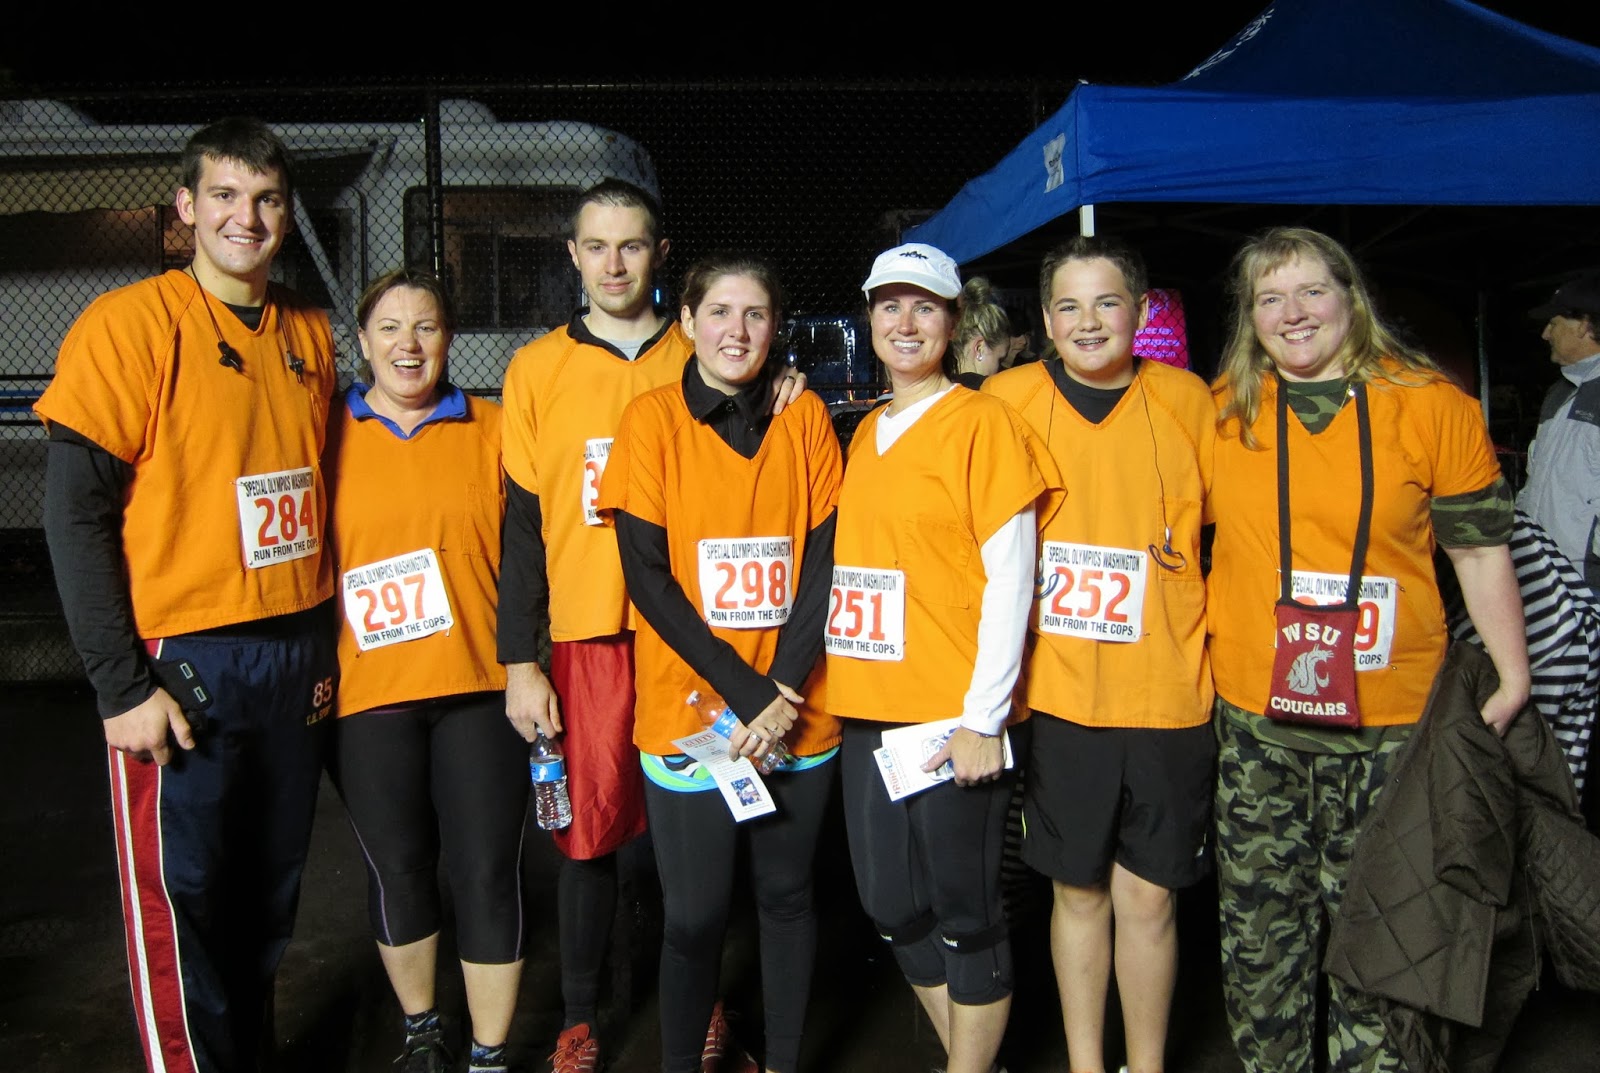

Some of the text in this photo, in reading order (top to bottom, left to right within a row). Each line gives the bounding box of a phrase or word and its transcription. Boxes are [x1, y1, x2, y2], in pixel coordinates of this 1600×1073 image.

[1133, 337, 1180, 347] ympics
[1135, 327, 1174, 337] pecial
[246, 479, 268, 497] SPECIAL
[268, 475, 291, 493] OLYMPICS
[254, 490, 314, 547] 284
[254, 548, 271, 561] RUN
[273, 544, 293, 558] FROM
[294, 540, 306, 553] THE
[706, 541, 791, 560] SPECIAL OLYMPICS WASHINGTON
[1048, 546, 1140, 572] SPECIAL OLYMPICS WASHINGTON
[347, 554, 431, 590] SPECIAL OLYMPICS WASHINGTON
[841, 570, 862, 588] OLYMPICS
[862, 572, 897, 591] WASHINGTON
[715, 560, 787, 610] 298
[1051, 566, 1131, 623] 252
[1292, 575, 1389, 599] PECIAL OLYMPICS SHINGTON
[355, 573, 426, 633] 297
[711, 607, 788, 622] RUN FROM THE COPS
[828, 587, 886, 641] 251
[363, 615, 446, 645] RUN FROM THE COPS
[1044, 614, 1134, 636] RUN FROM THE COPS
[1281, 622, 1342, 646] WSU
[834, 638, 854, 650] FROM
[856, 641, 870, 652] THE
[872, 643, 895, 655] COPS
[1358, 654, 1382, 665] COPS
[313, 677, 332, 708] 85
[1270, 696, 1348, 716] COUGARS
